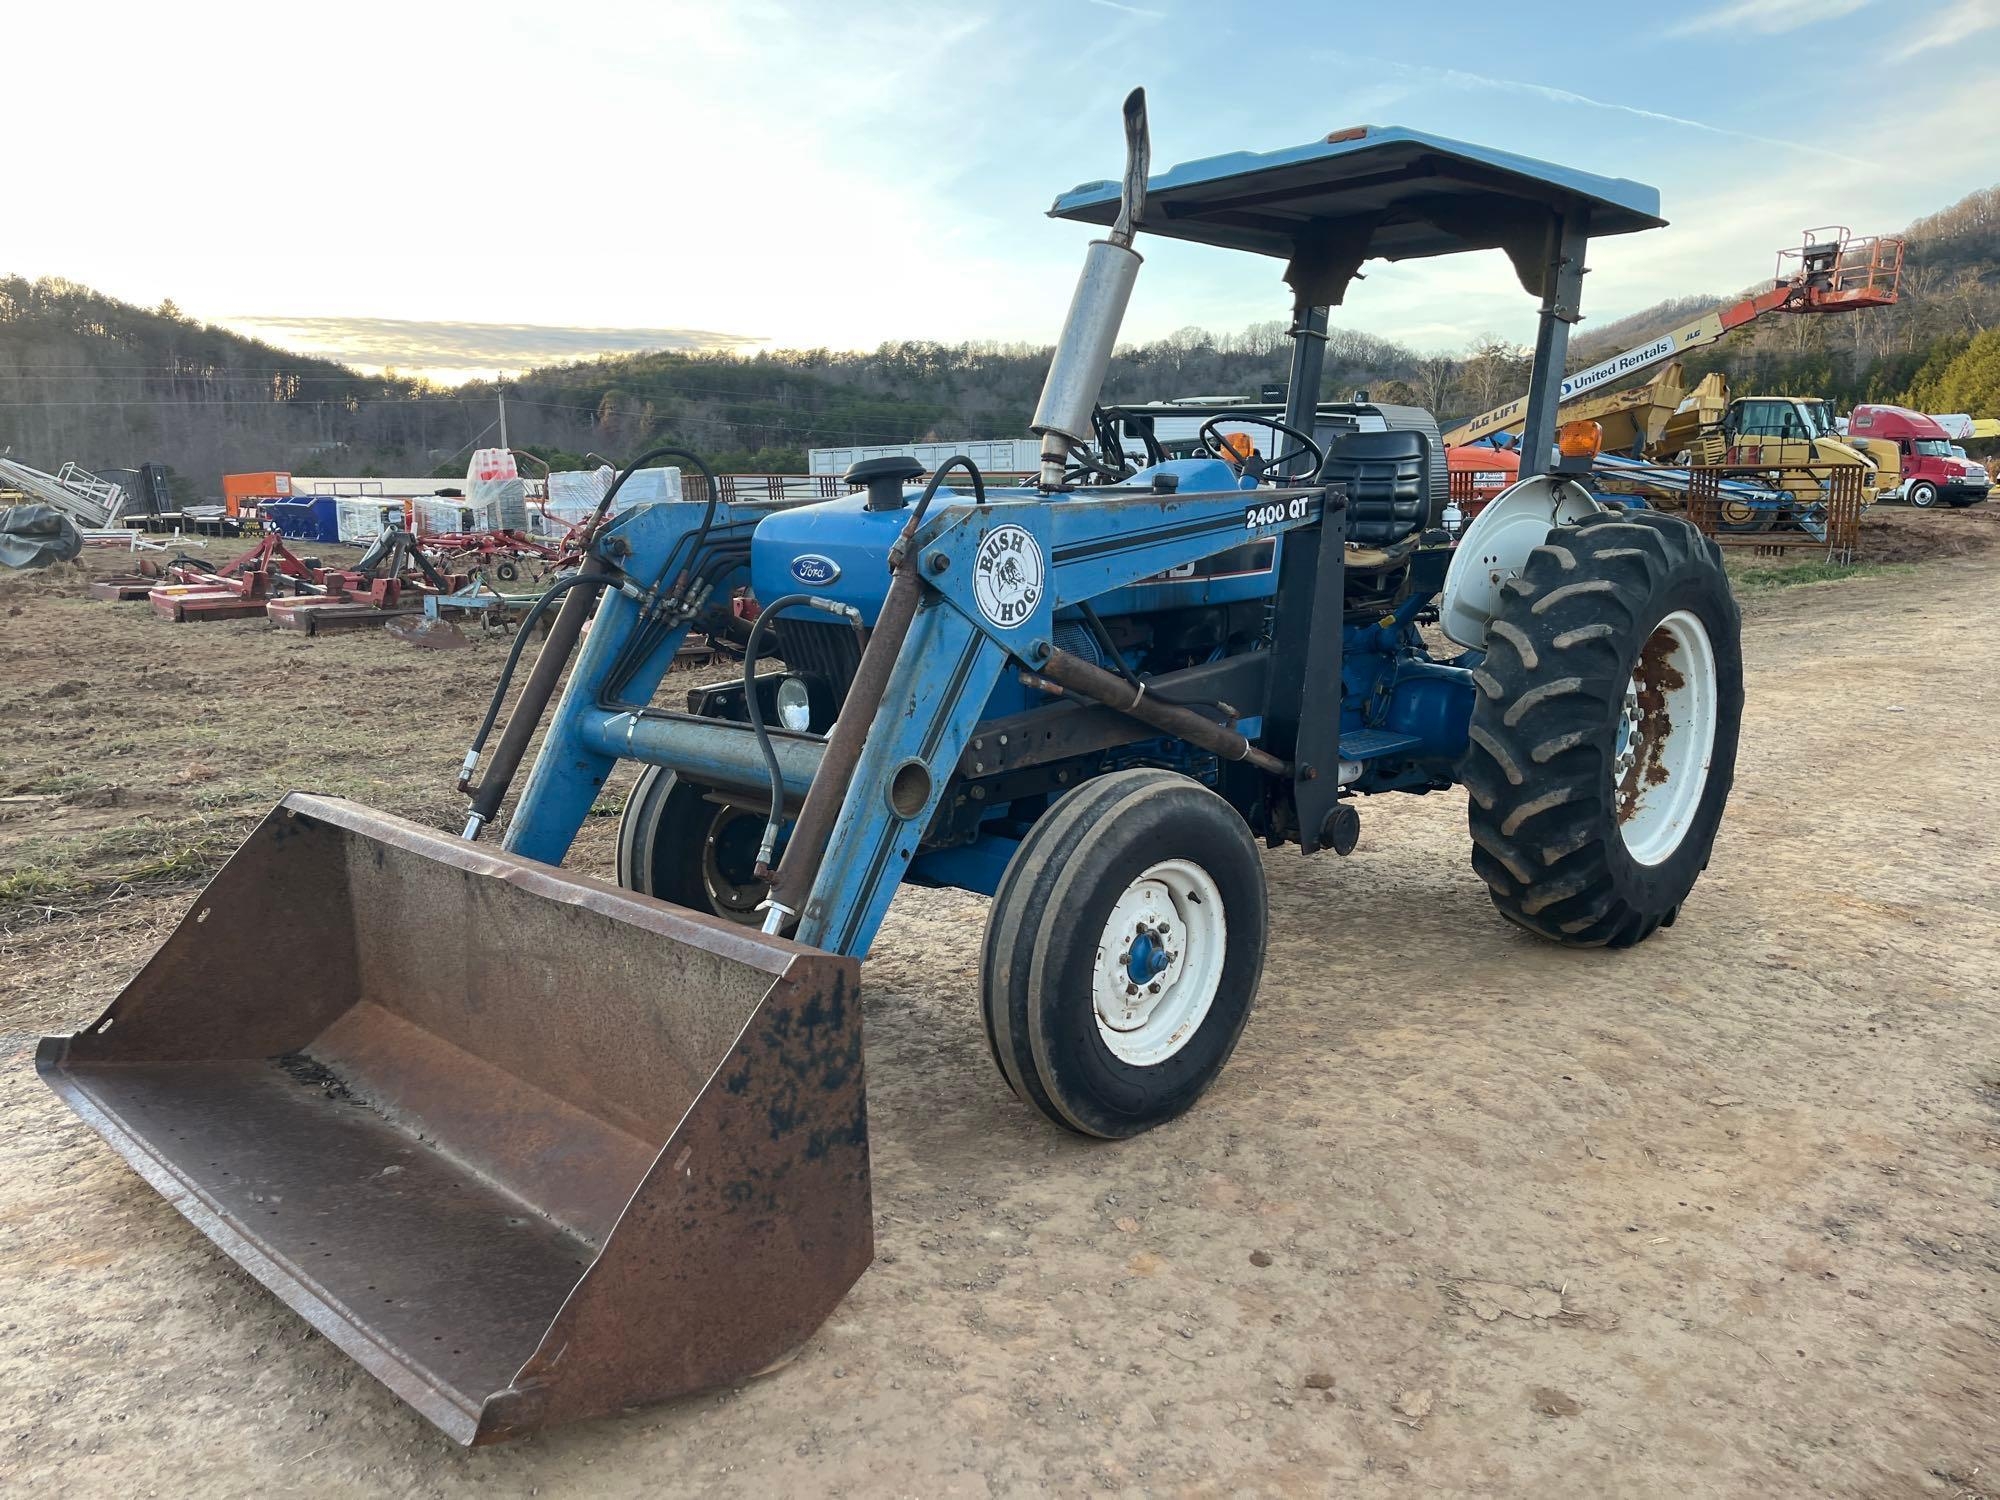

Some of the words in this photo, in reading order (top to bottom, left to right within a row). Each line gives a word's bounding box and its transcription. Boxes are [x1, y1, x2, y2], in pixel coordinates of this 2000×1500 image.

[1684, 329, 1701, 341] JLG
[1574, 363, 1616, 389] United
[1619, 343, 1668, 370] Rentals
[1469, 415, 1490, 432] JLG
[1493, 402, 1519, 421] LIFT
[1246, 503, 1285, 529] 2400
[1288, 496, 1309, 519] QT
[799, 560, 826, 578] Ford
[979, 532, 1025, 574] BUSH
[1000, 588, 1037, 621] HOG
